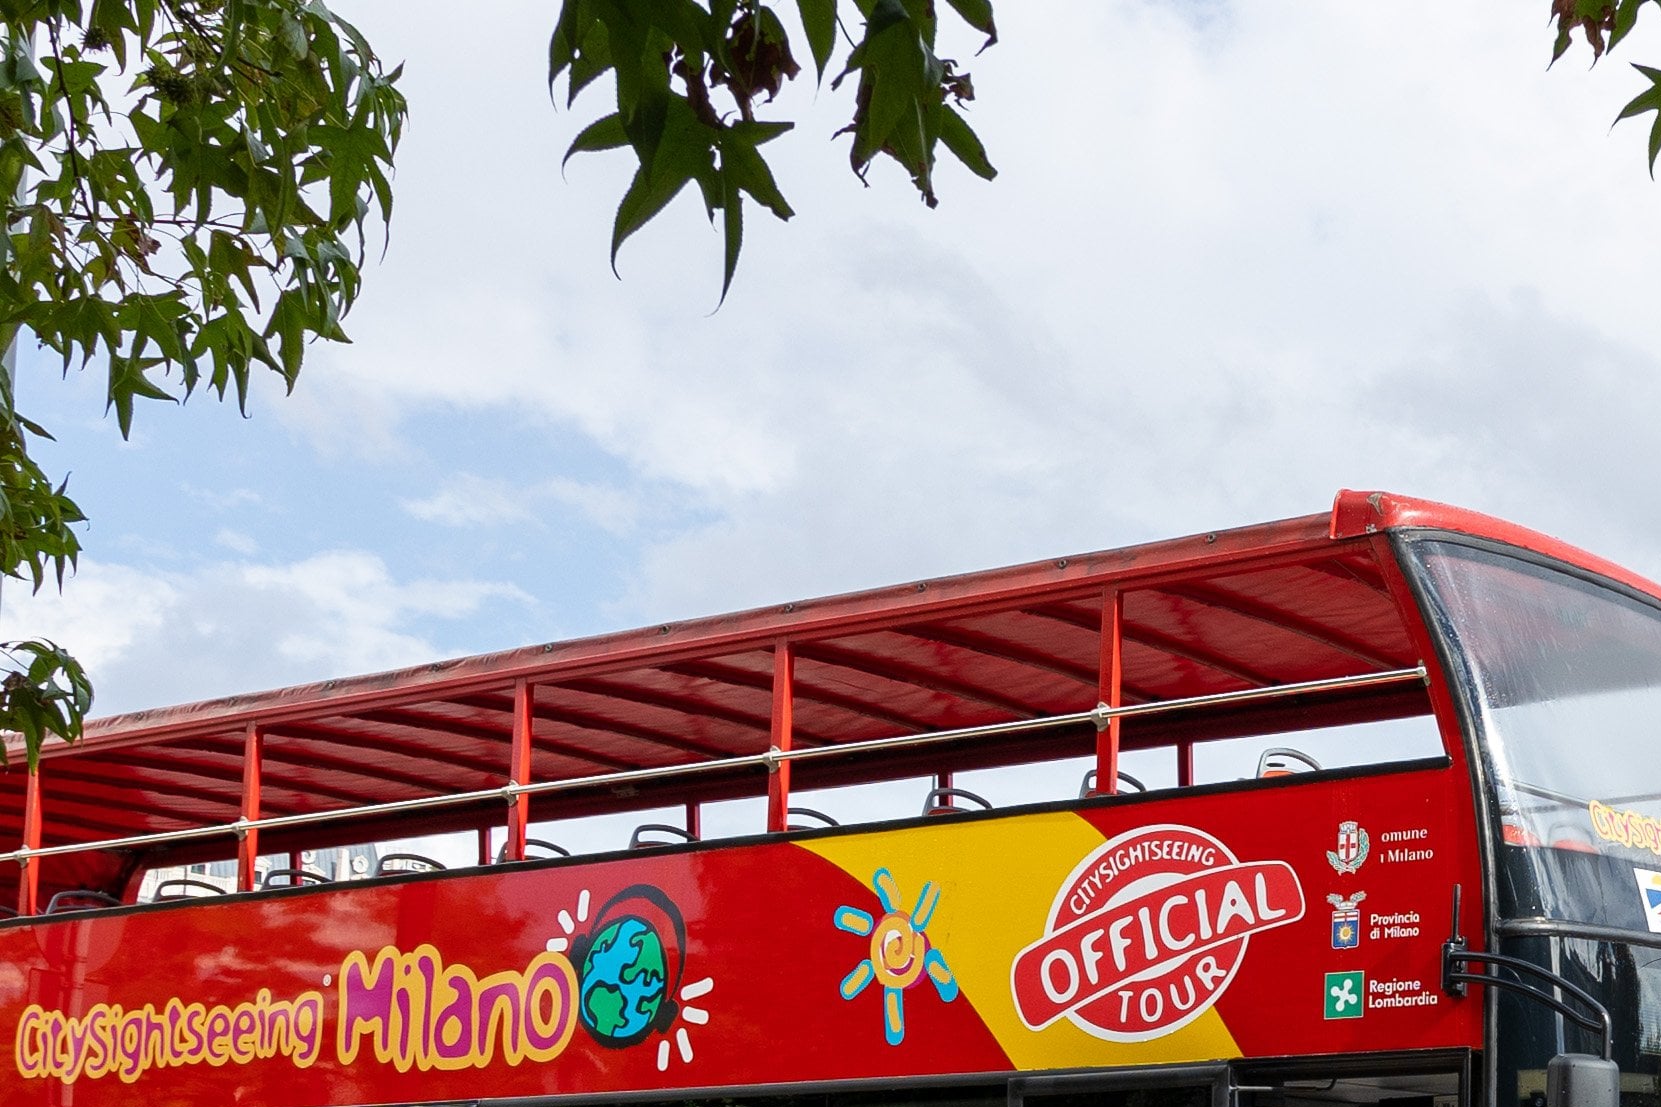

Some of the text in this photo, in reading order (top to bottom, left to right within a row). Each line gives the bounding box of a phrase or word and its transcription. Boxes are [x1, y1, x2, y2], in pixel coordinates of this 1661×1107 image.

[1381, 828, 1428, 842] omune
[1388, 848, 1434, 862] Milano
[1070, 840, 1215, 915] CITYSIGHTSEEING
[1370, 911, 1420, 926] Provincia
[1040, 873, 1286, 1004] OFFICIAL
[1370, 926, 1420, 939] di Milano
[1118, 955, 1227, 1024] TOUR
[1369, 980, 1421, 995] Regione
[1368, 992, 1438, 1008] Lombardia
[337, 944, 579, 1073] Milano
